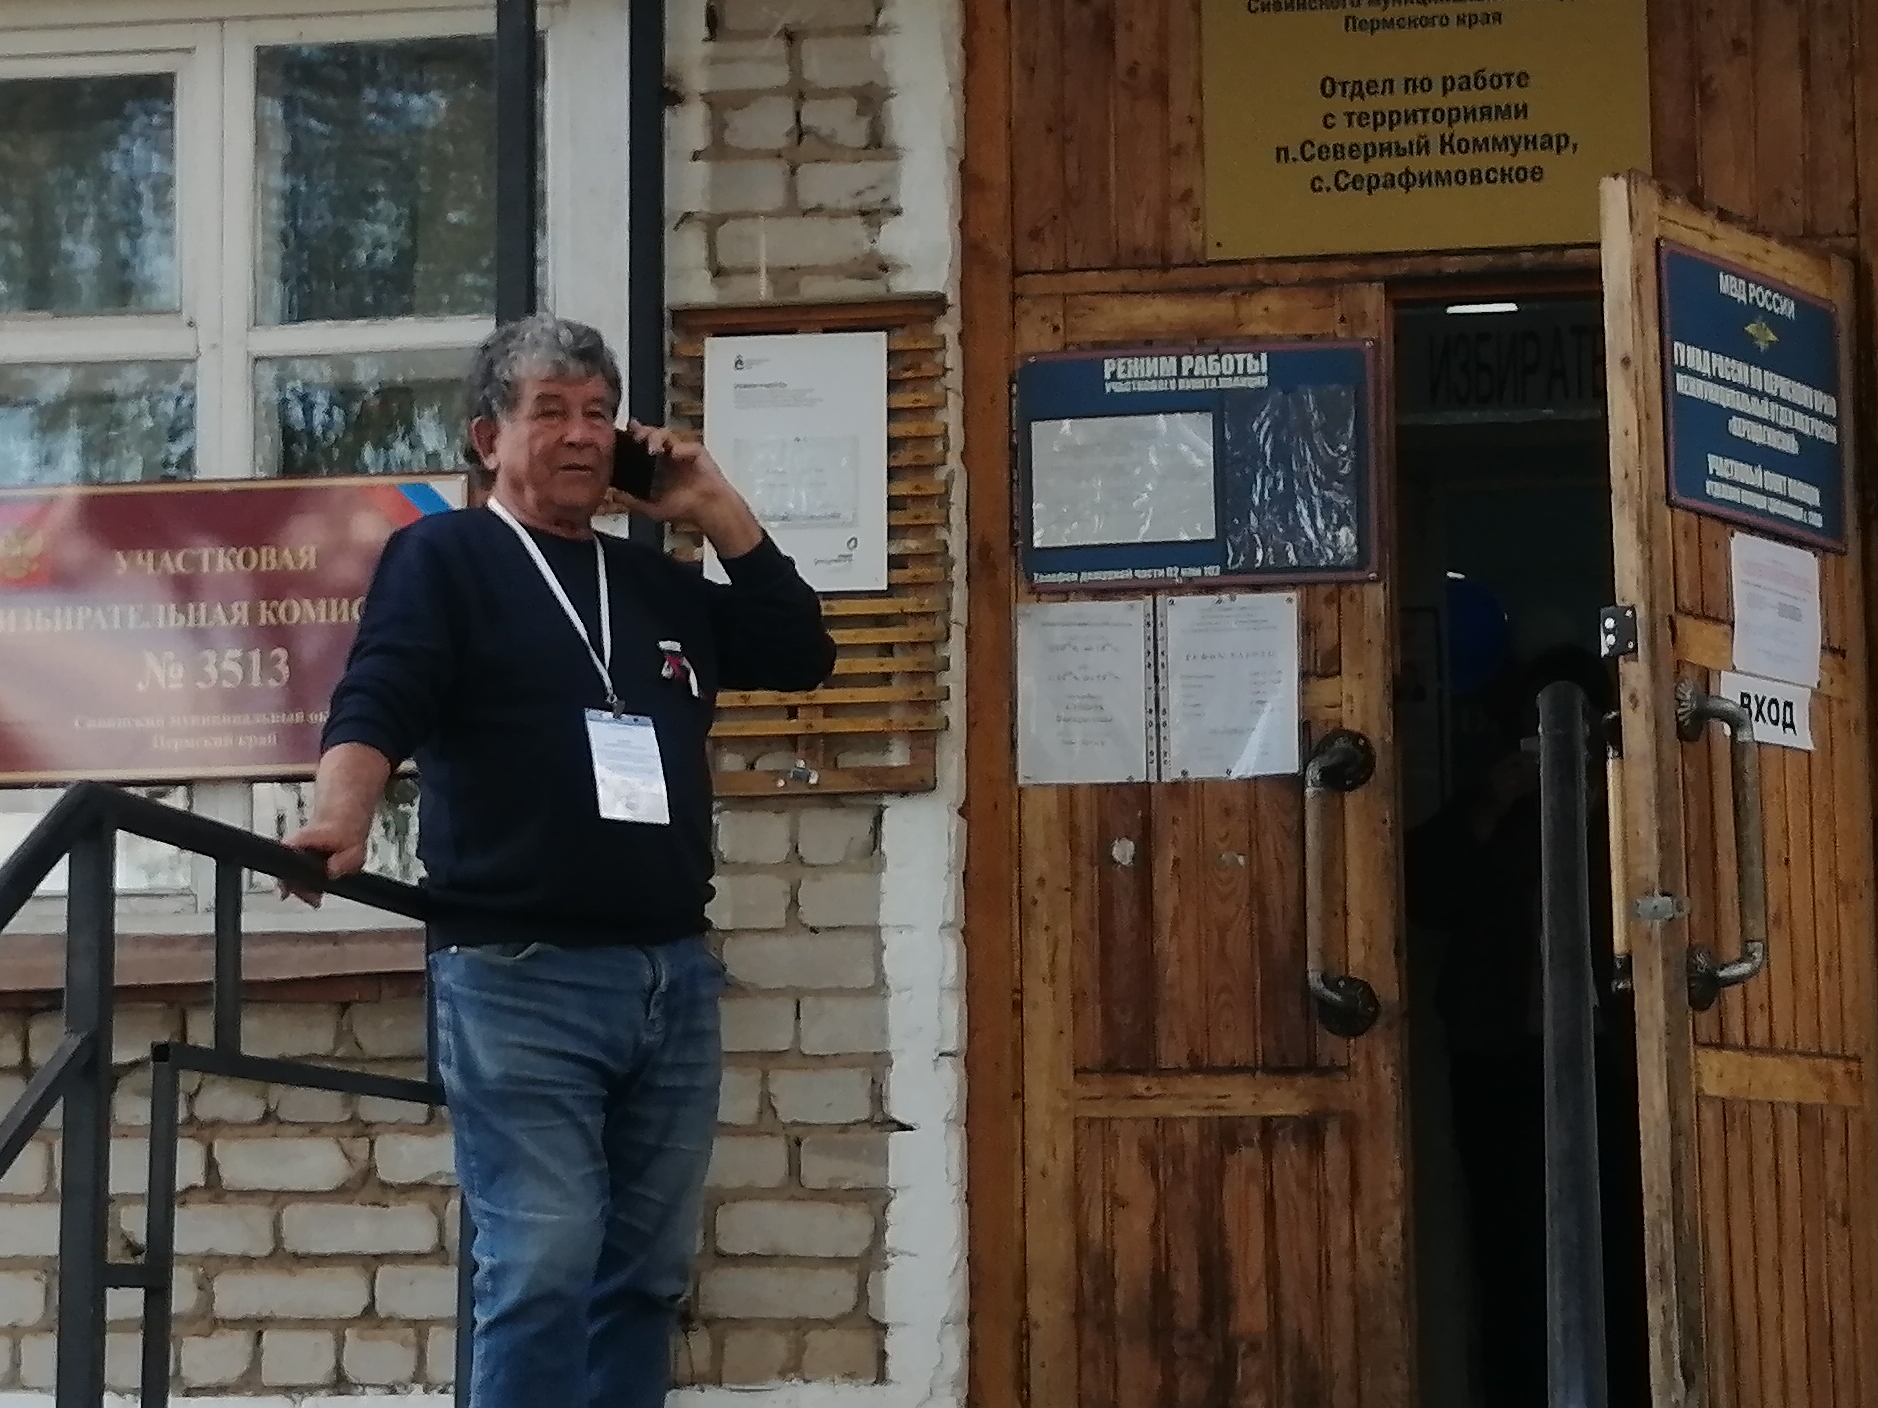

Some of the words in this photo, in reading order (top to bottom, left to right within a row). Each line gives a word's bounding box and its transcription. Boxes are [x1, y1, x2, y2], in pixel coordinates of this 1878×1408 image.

[1343, 13, 1450, 36] Пермского
[1455, 10, 1503, 31] края
[1319, 75, 1395, 102] Отдел
[1403, 74, 1434, 95] по
[1441, 69, 1532, 98] работе
[1321, 109, 1337, 130] с
[1342, 100, 1530, 133] территориями
[1274, 133, 1432, 165] п.Северный
[1438, 130, 1580, 159] Коммунар,
[1718, 271, 1748, 306] МВД
[1748, 282, 1796, 321] РОССИИ
[1103, 356, 1177, 381] РЕЖИМ
[1181, 351, 1268, 377] РАБОТЫ
[113, 544, 318, 576] УЧАСТКОВАЯ
[135, 648, 185, 692] №
[196, 646, 291, 690] 3513
[1739, 692, 1798, 737] ВХОД
